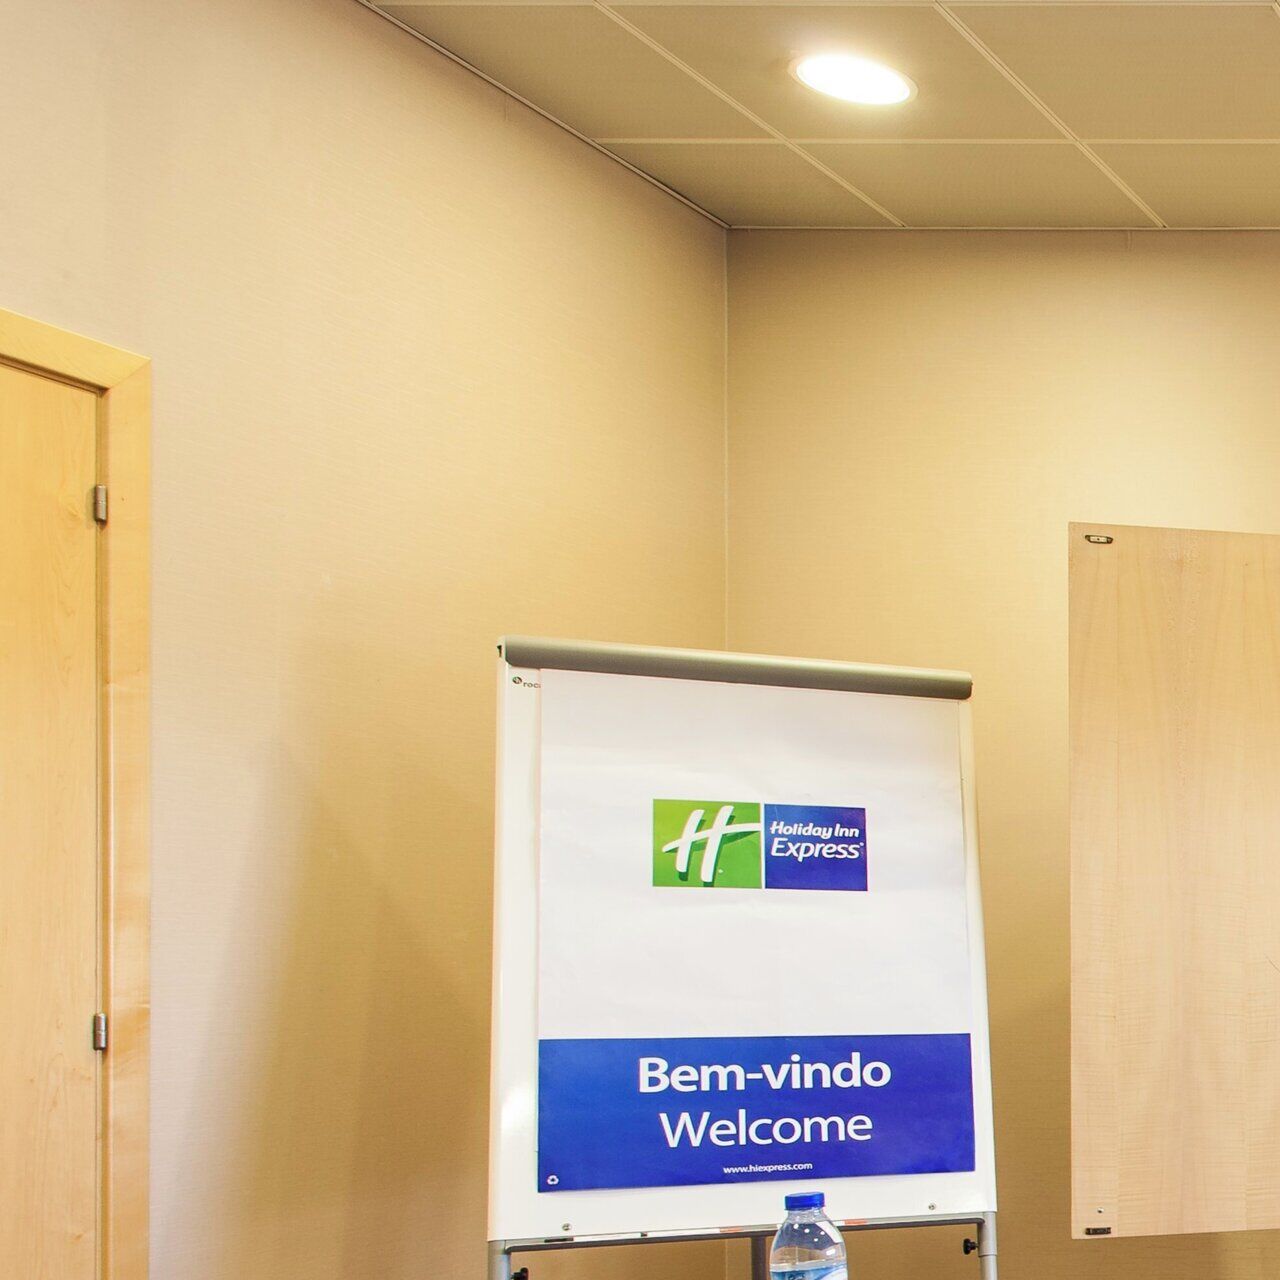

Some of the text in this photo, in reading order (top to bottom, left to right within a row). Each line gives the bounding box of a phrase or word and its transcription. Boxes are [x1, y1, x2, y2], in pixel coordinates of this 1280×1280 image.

[770, 820, 860, 840] Holiday Inn
[771, 837, 861, 862] Express
[638, 1052, 892, 1093] Bem-vindo
[659, 1108, 873, 1148] Welcome
[723, 1162, 813, 1174] www.hiexpress.com
